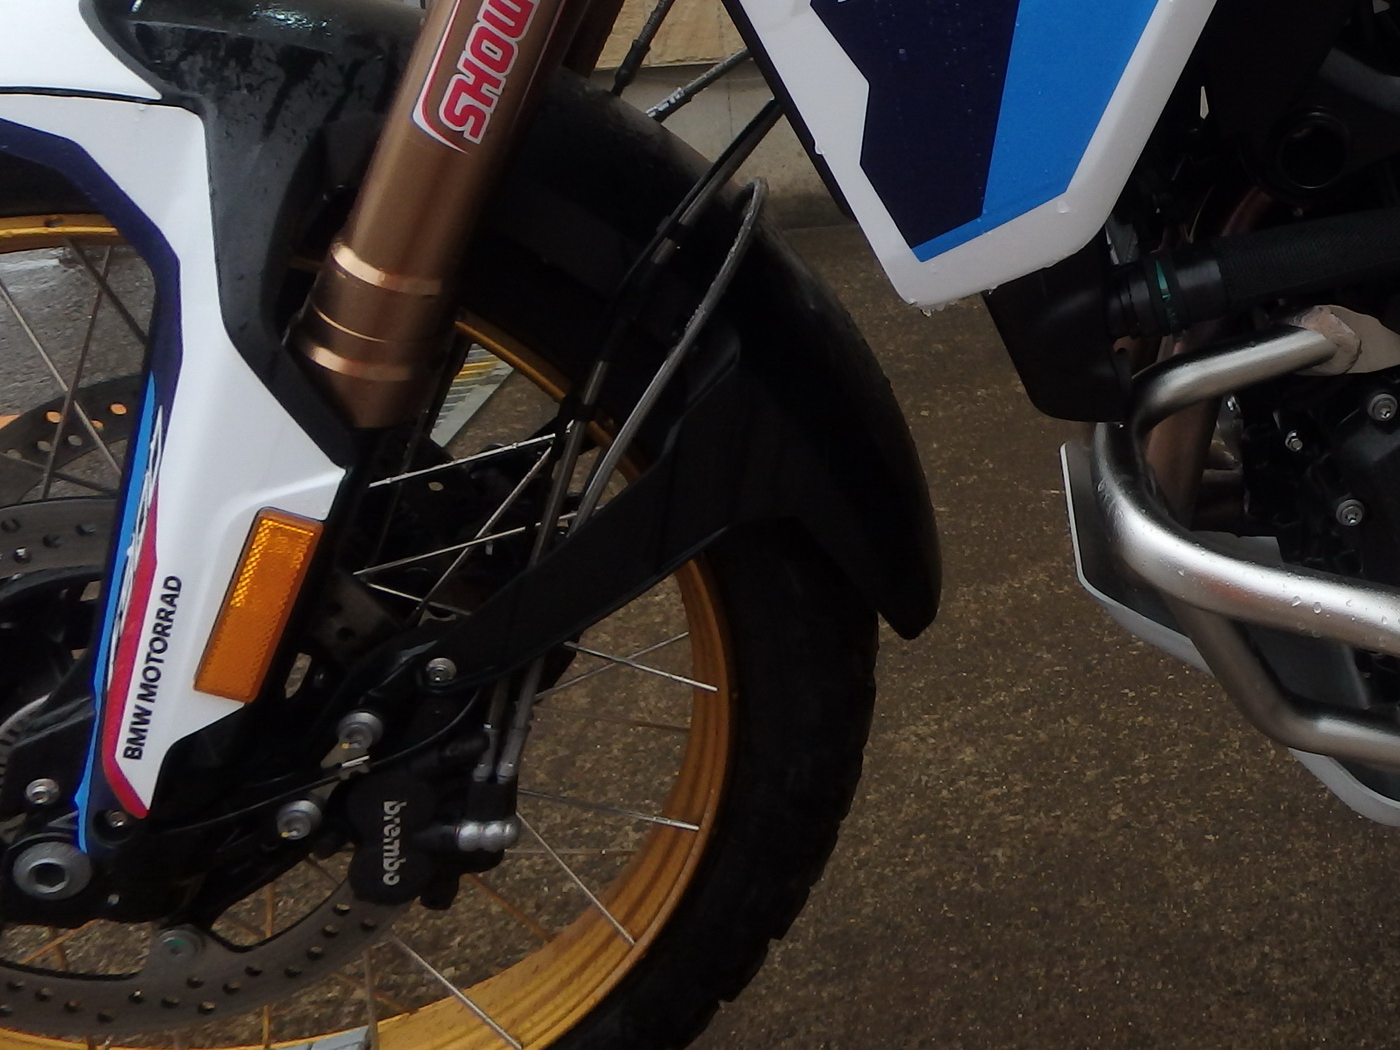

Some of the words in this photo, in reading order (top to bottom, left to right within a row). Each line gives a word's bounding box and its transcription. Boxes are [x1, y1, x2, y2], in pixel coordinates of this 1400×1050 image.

[137, 575, 182, 703] MOTORRAD
[122, 705, 153, 760] BMW
[383, 800, 407, 886] brembo
